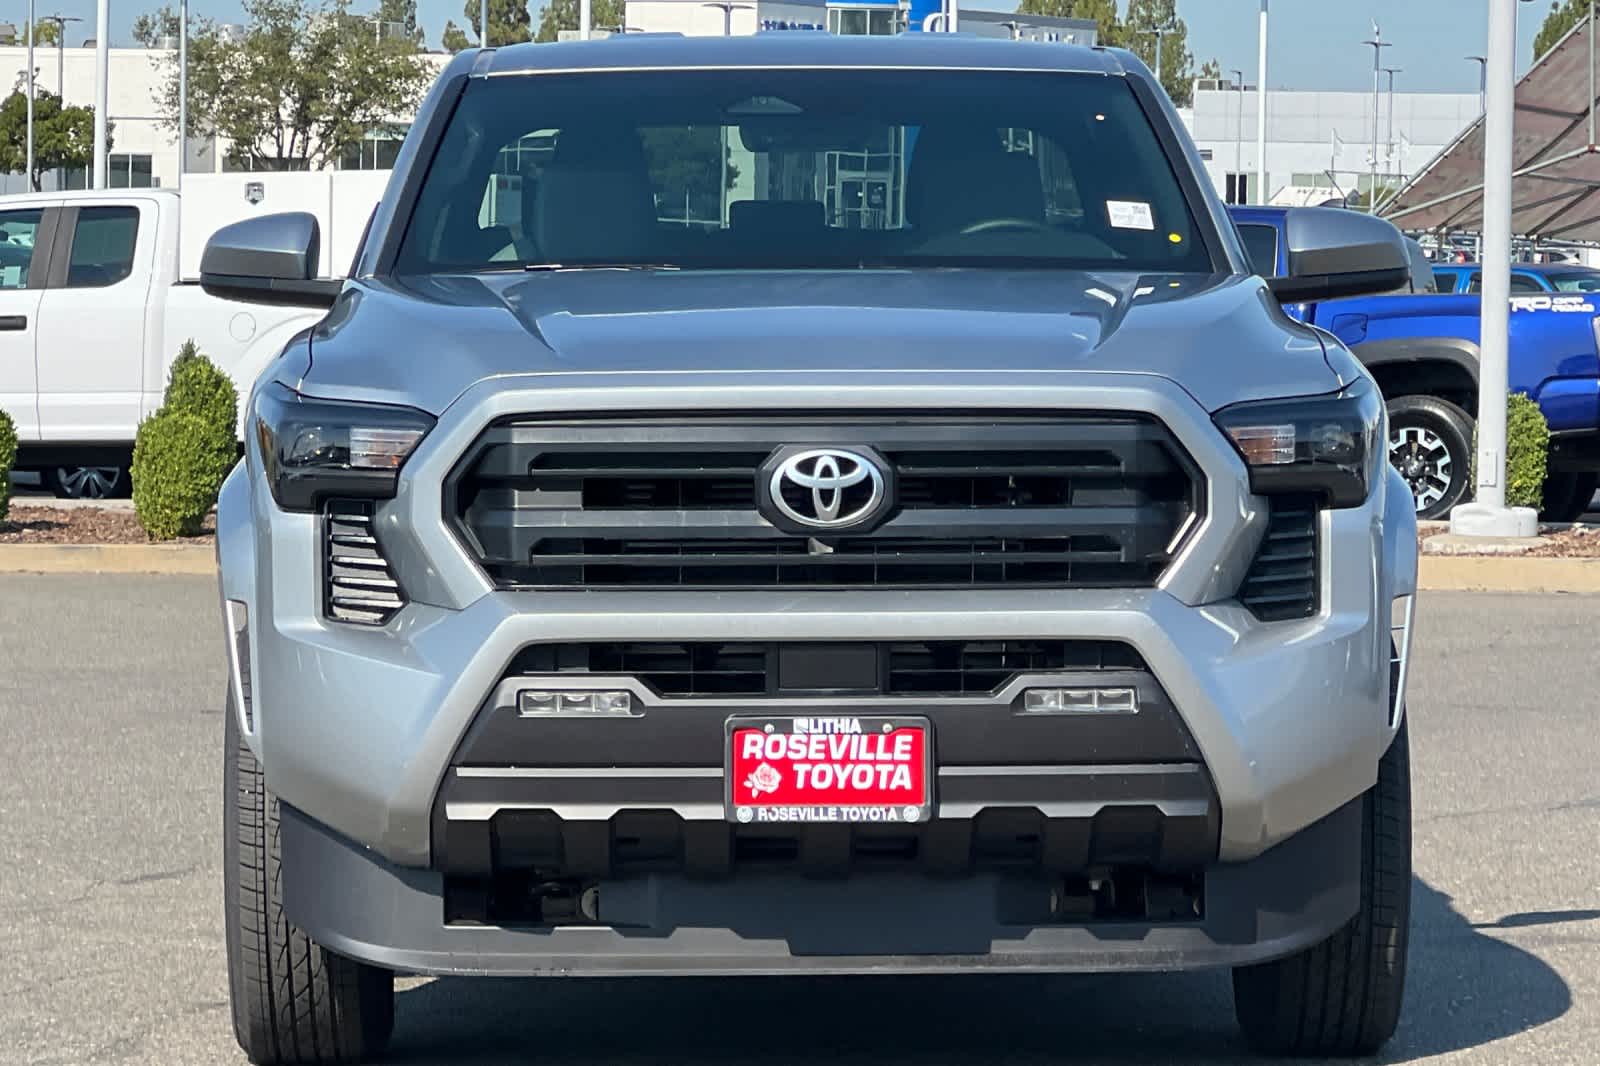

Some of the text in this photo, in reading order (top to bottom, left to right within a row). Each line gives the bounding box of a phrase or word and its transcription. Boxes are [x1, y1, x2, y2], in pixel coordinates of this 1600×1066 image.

[808, 718, 862, 734] LITHIA
[742, 734, 913, 761] ROSEVILLE
[792, 763, 912, 790] TOYOTA
[758, 807, 897, 821] ROSEVILLE TOYOTA
